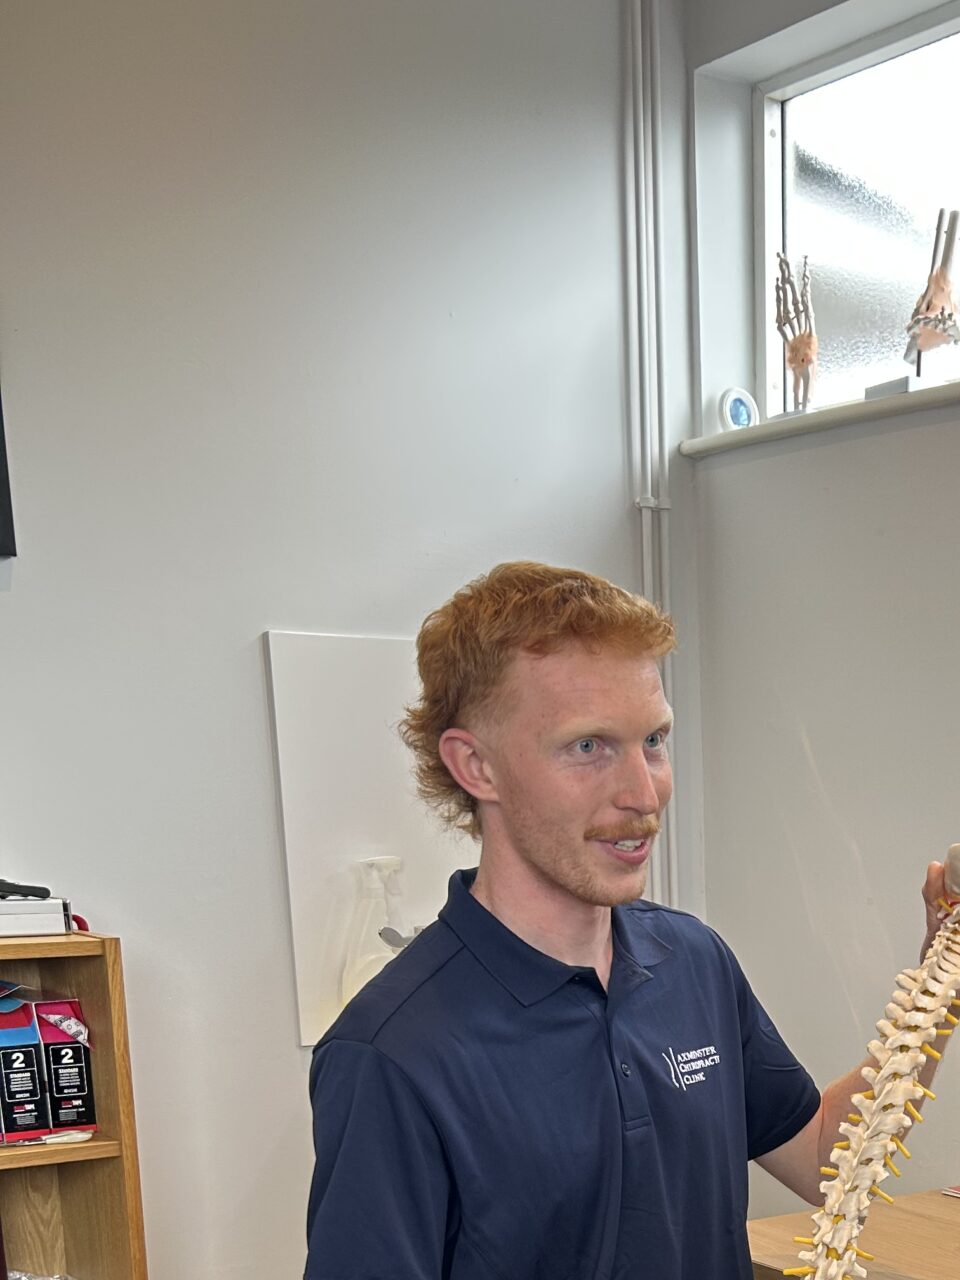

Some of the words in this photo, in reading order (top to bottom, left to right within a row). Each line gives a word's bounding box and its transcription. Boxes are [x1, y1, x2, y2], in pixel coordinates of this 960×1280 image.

[11, 1052, 26, 1068] 2
[61, 1048, 74, 1064] 2
[678, 1046, 717, 1063] AXMINSTER
[683, 1072, 706, 1085] CLINIC
